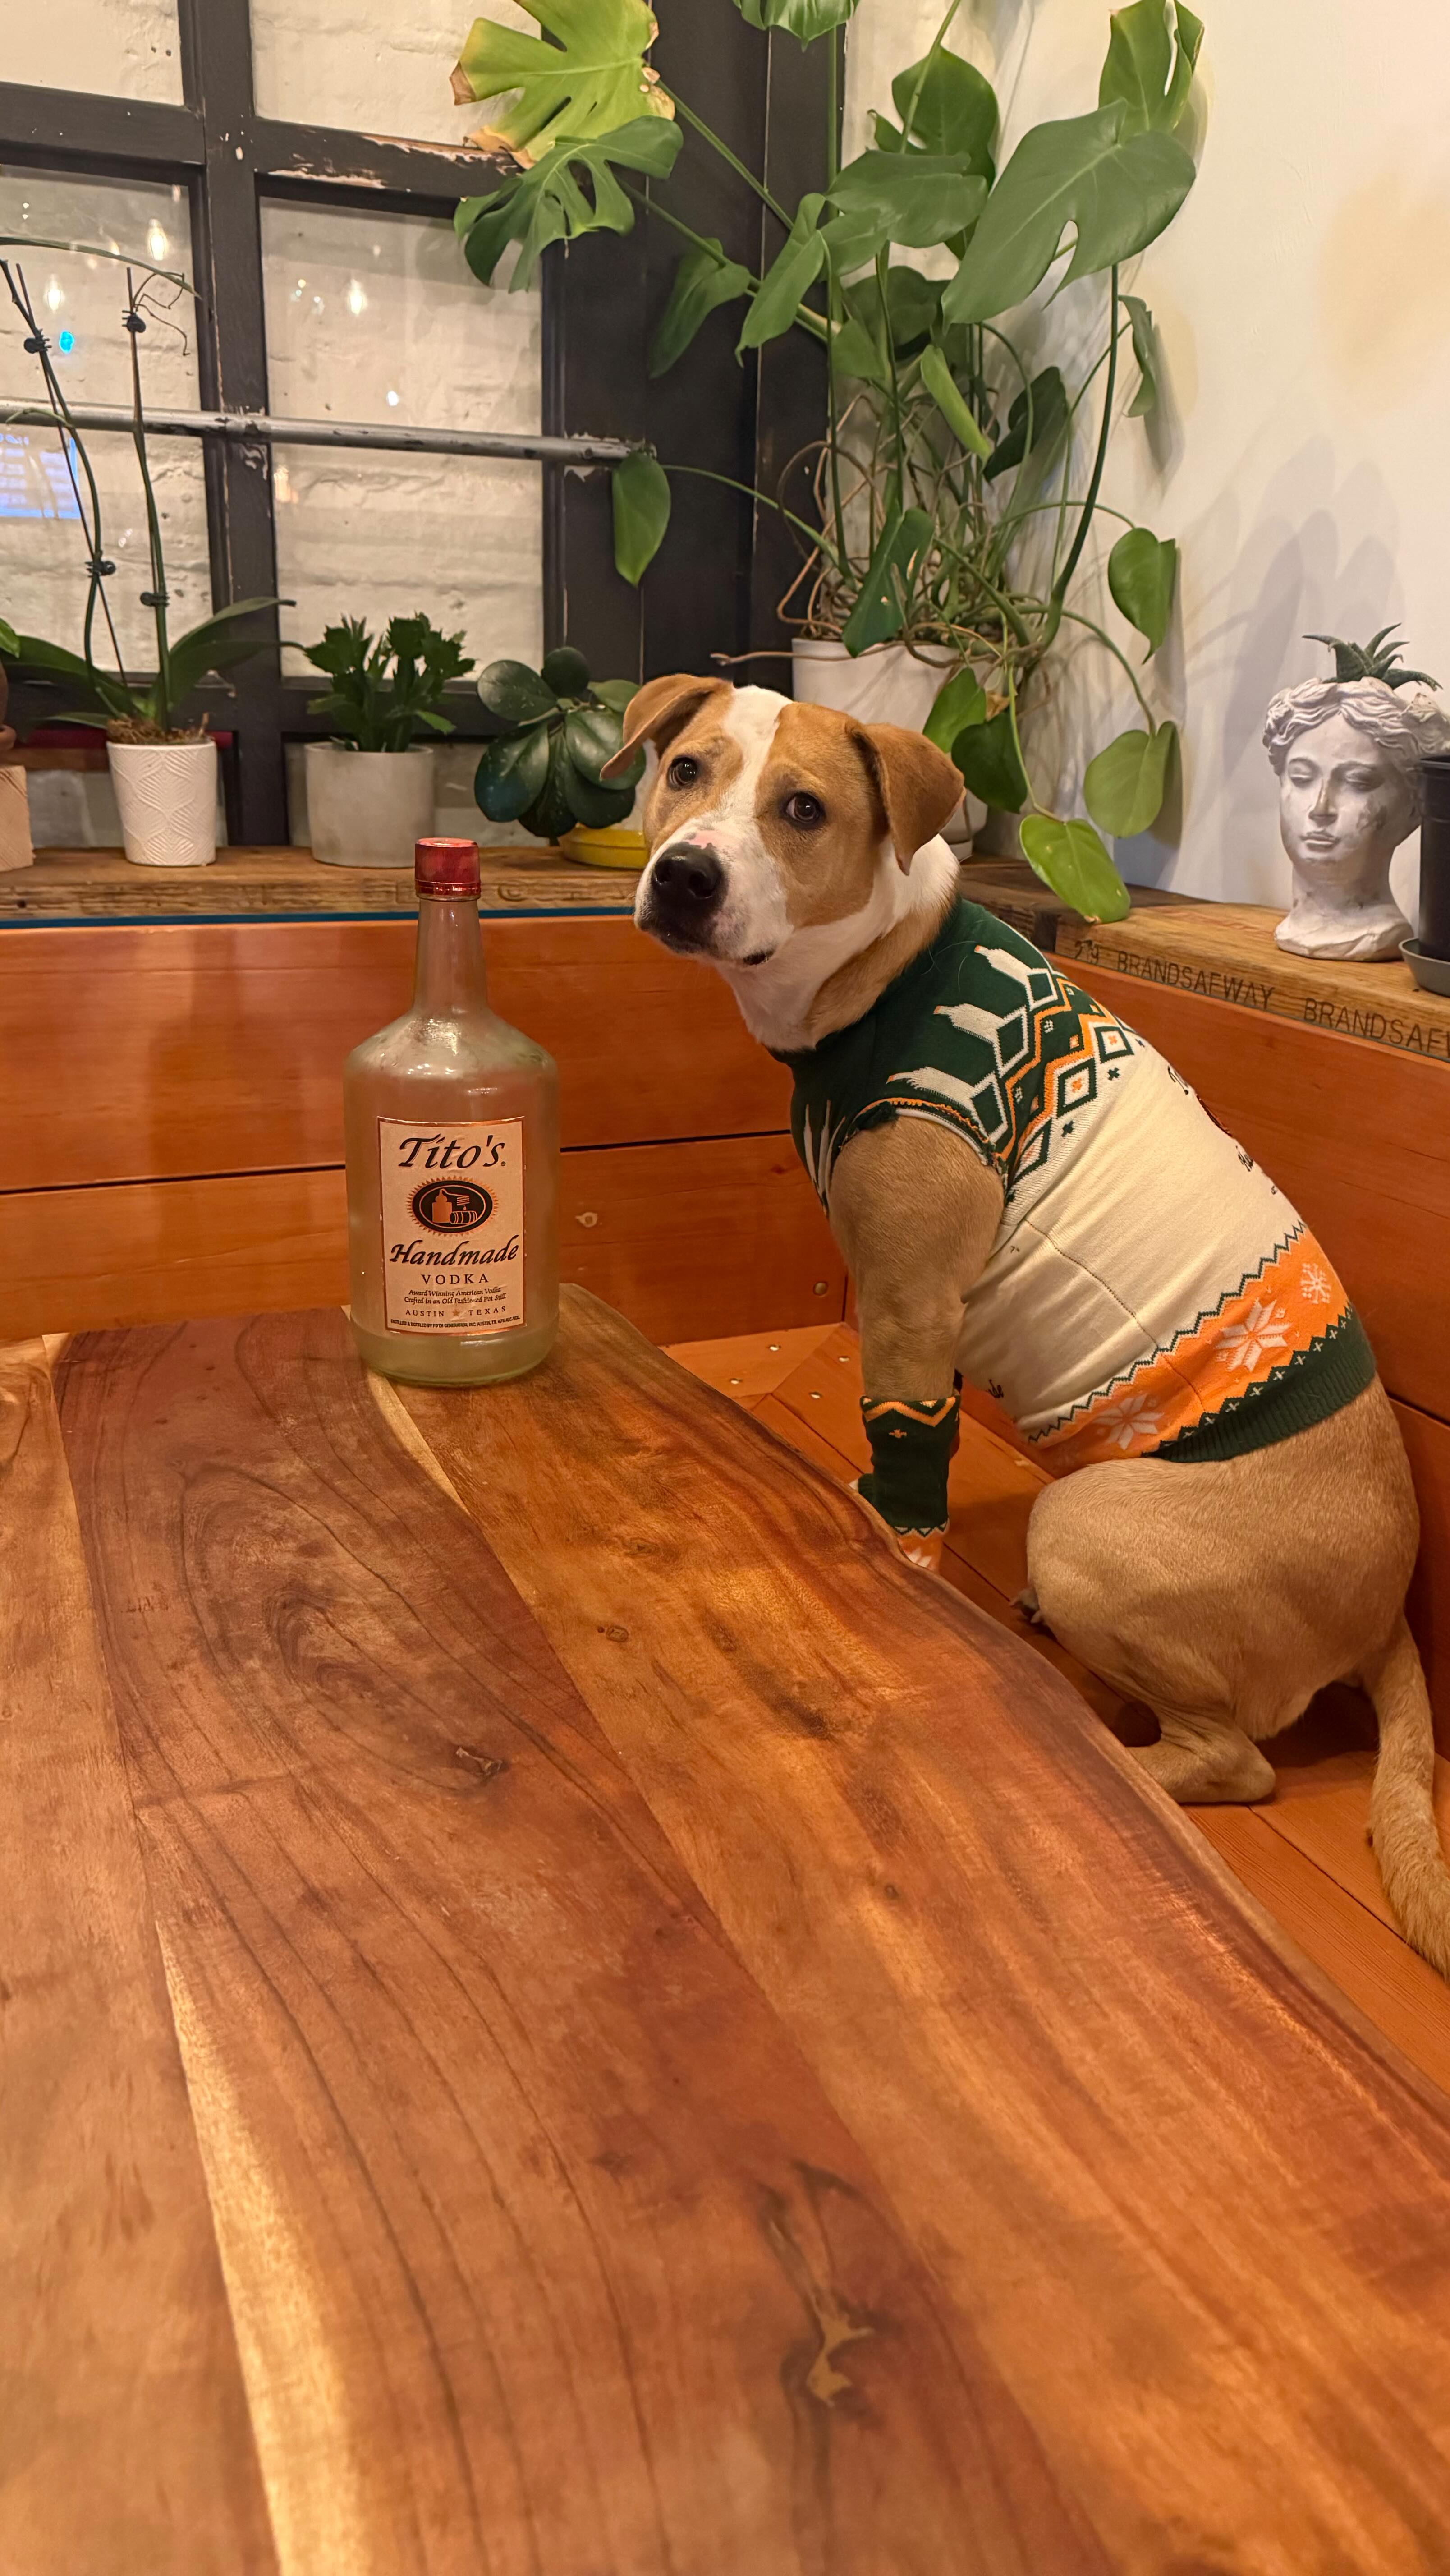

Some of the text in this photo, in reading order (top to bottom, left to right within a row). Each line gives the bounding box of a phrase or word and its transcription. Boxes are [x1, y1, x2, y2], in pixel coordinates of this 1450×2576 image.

[1118, 950, 1275, 1009] BRANDSAFWAY
[1304, 998, 1450, 1058] BRANDSAF
[398, 1133, 505, 1169] Tito's
[389, 1234, 519, 1265] Handmade
[421, 1273, 489, 1285] VODKA
[404, 1297, 424, 1305] Crafted
[468, 1306, 506, 1316] TEXAS
